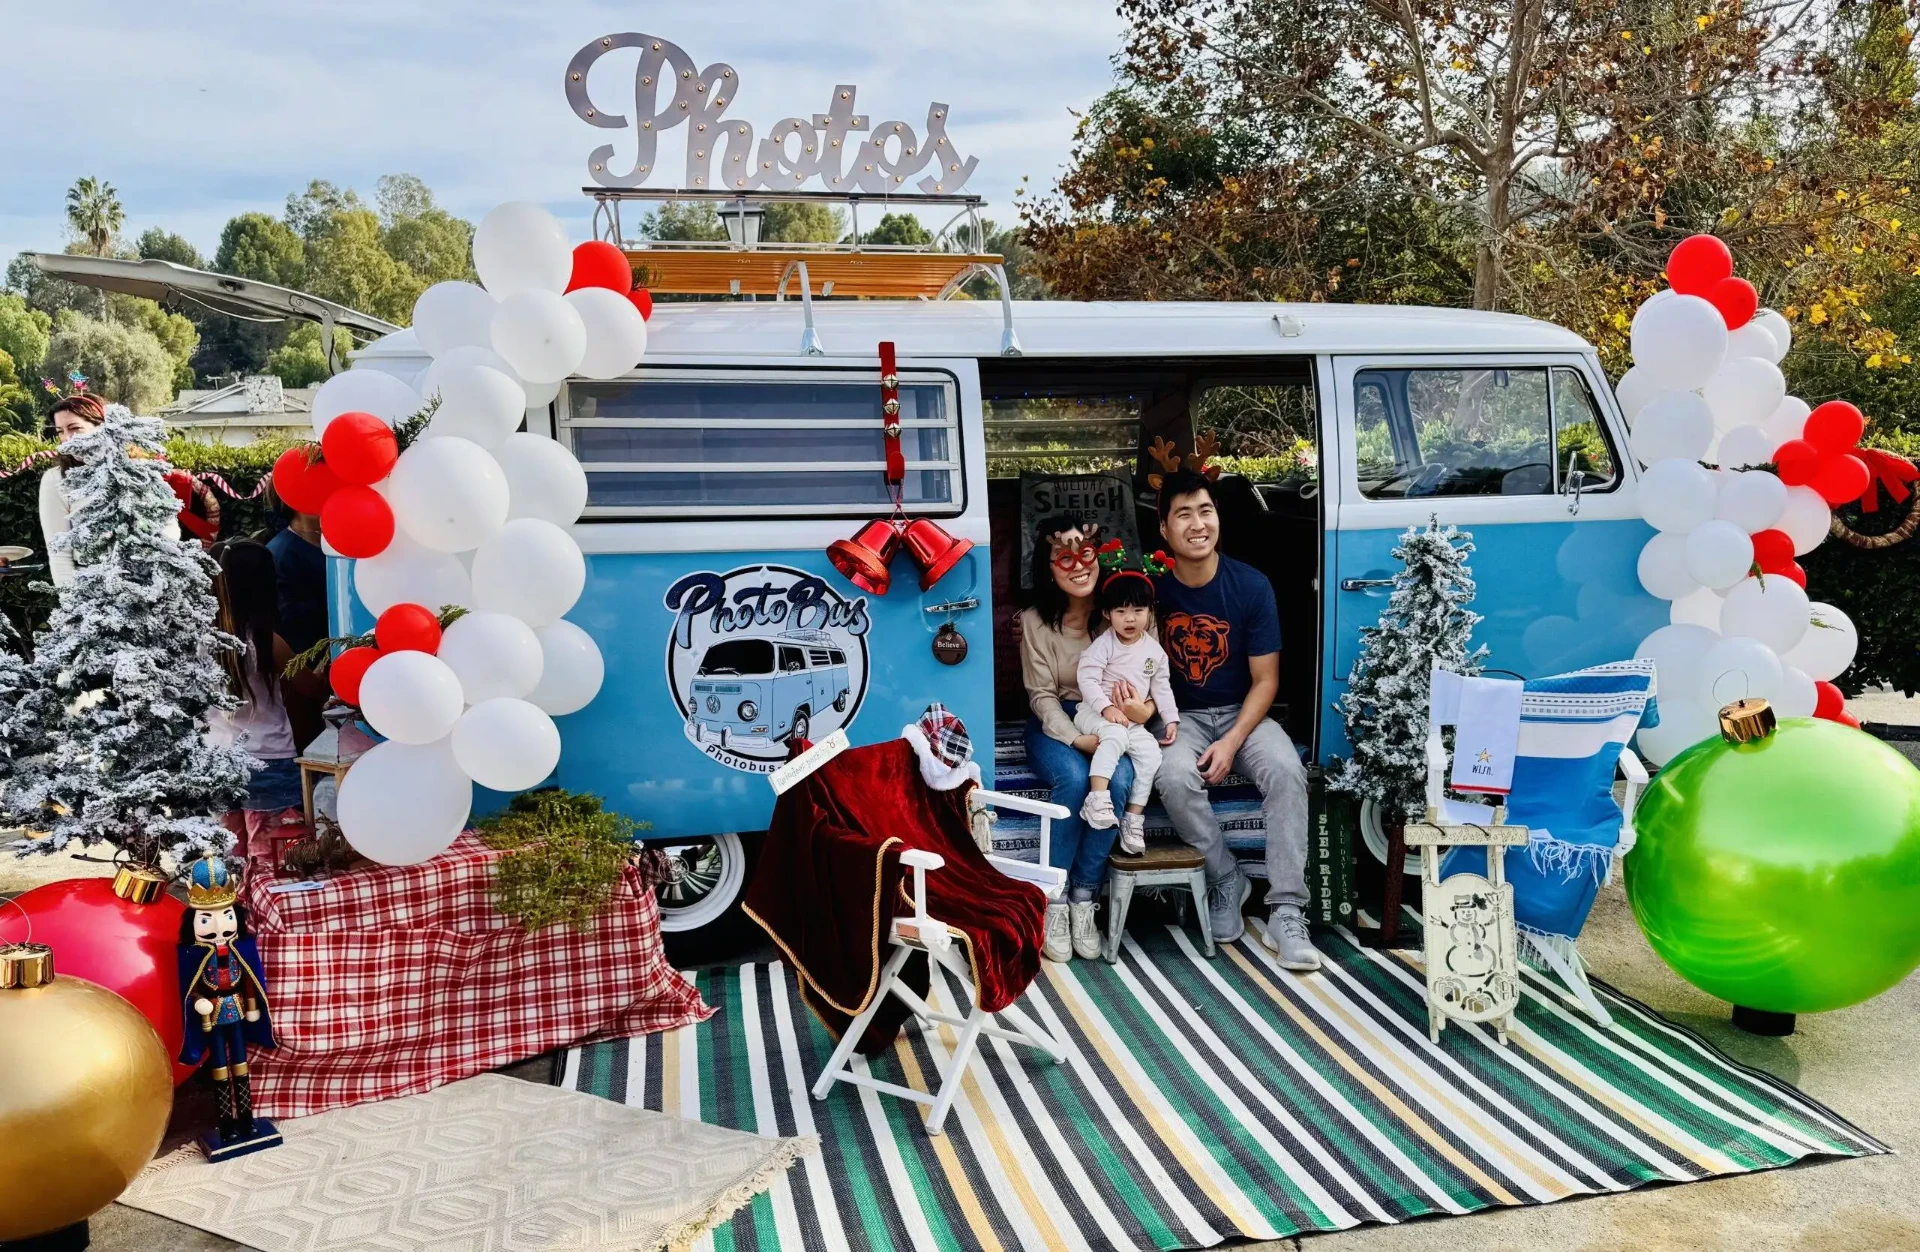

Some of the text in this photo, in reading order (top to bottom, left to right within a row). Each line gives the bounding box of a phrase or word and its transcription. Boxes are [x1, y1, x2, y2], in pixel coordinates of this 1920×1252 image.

[565, 32, 979, 194] Photos
[1034, 485, 1124, 512] SLEIGH
[1053, 479, 1104, 492] HOLIDAY
[937, 641, 960, 649] Believe
[1318, 814, 1331, 921] SLED RIDES
